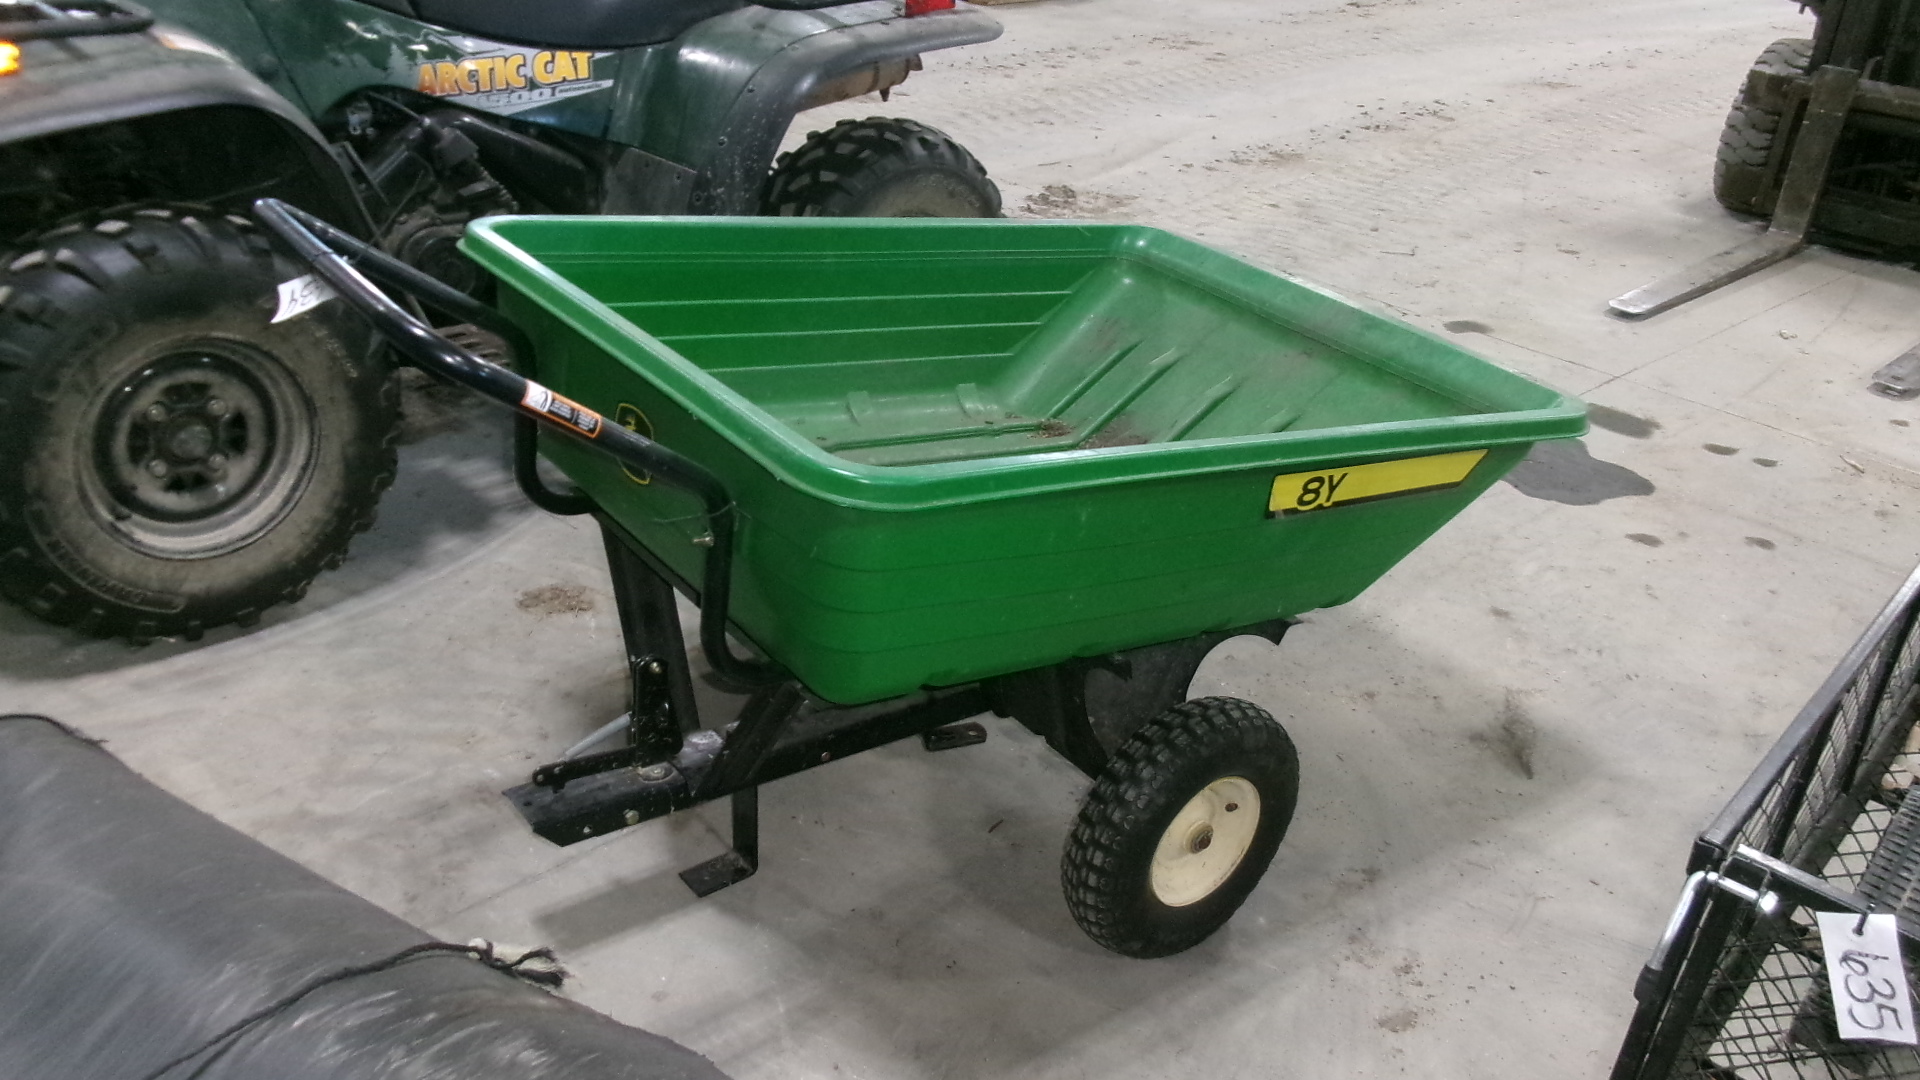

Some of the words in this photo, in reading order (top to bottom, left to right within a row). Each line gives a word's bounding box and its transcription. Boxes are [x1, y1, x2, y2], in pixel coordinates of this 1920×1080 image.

[418, 54, 527, 97] ARCTIC
[531, 50, 594, 85] CAT
[1296, 472, 1349, 507] 8Y
[1839, 949, 1904, 1031] 635
